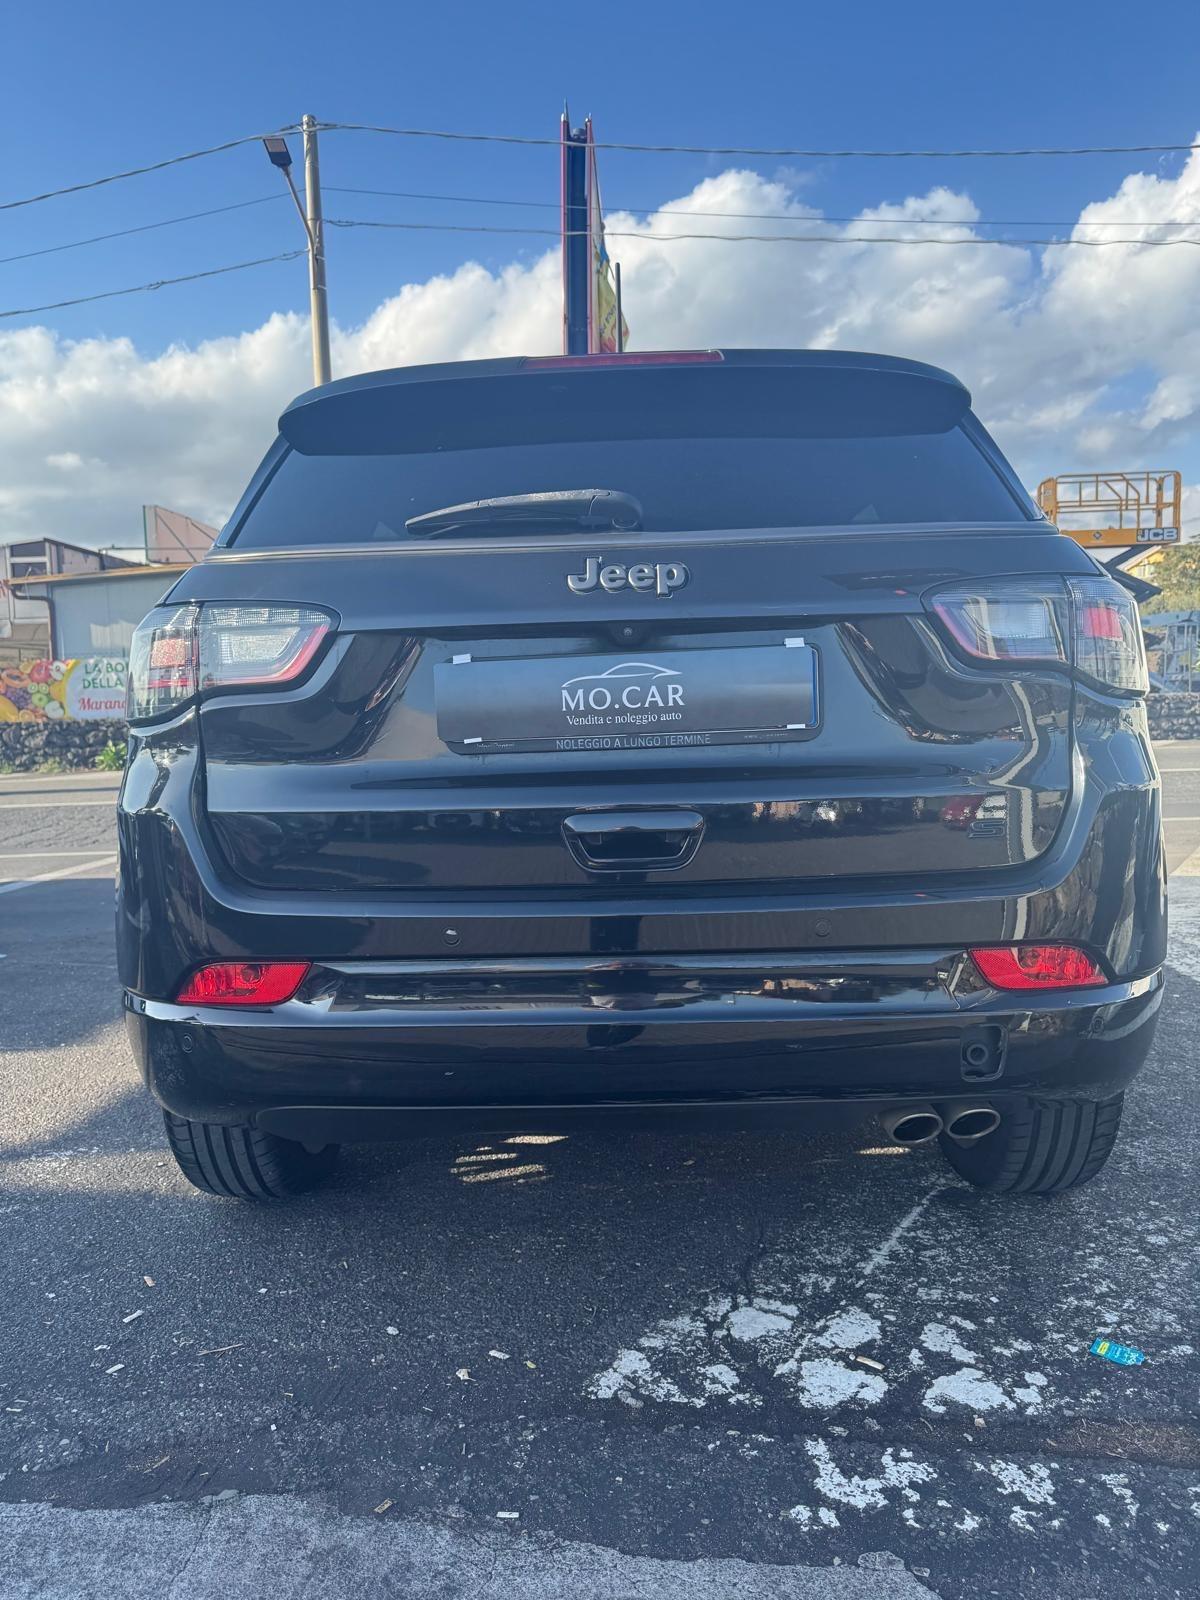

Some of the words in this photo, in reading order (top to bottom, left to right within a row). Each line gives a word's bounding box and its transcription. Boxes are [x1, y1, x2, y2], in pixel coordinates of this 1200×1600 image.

[1137, 528, 1178, 541] JCB
[567, 556, 690, 599] Jeep
[85, 662, 102, 674] LA
[82, 677, 124, 688] DELLA
[561, 684, 686, 711] MO.CAR
[566, 714, 604, 726] Vendita
[606, 716, 612, 724] e
[615, 712, 658, 725] noleggio
[660, 712, 682, 721] auto
[556, 738, 611, 750] NOLEGGIO
[613, 738, 621, 748] A
[623, 736, 661, 747] LUNGO
[663, 734, 712, 746] TERMINE
